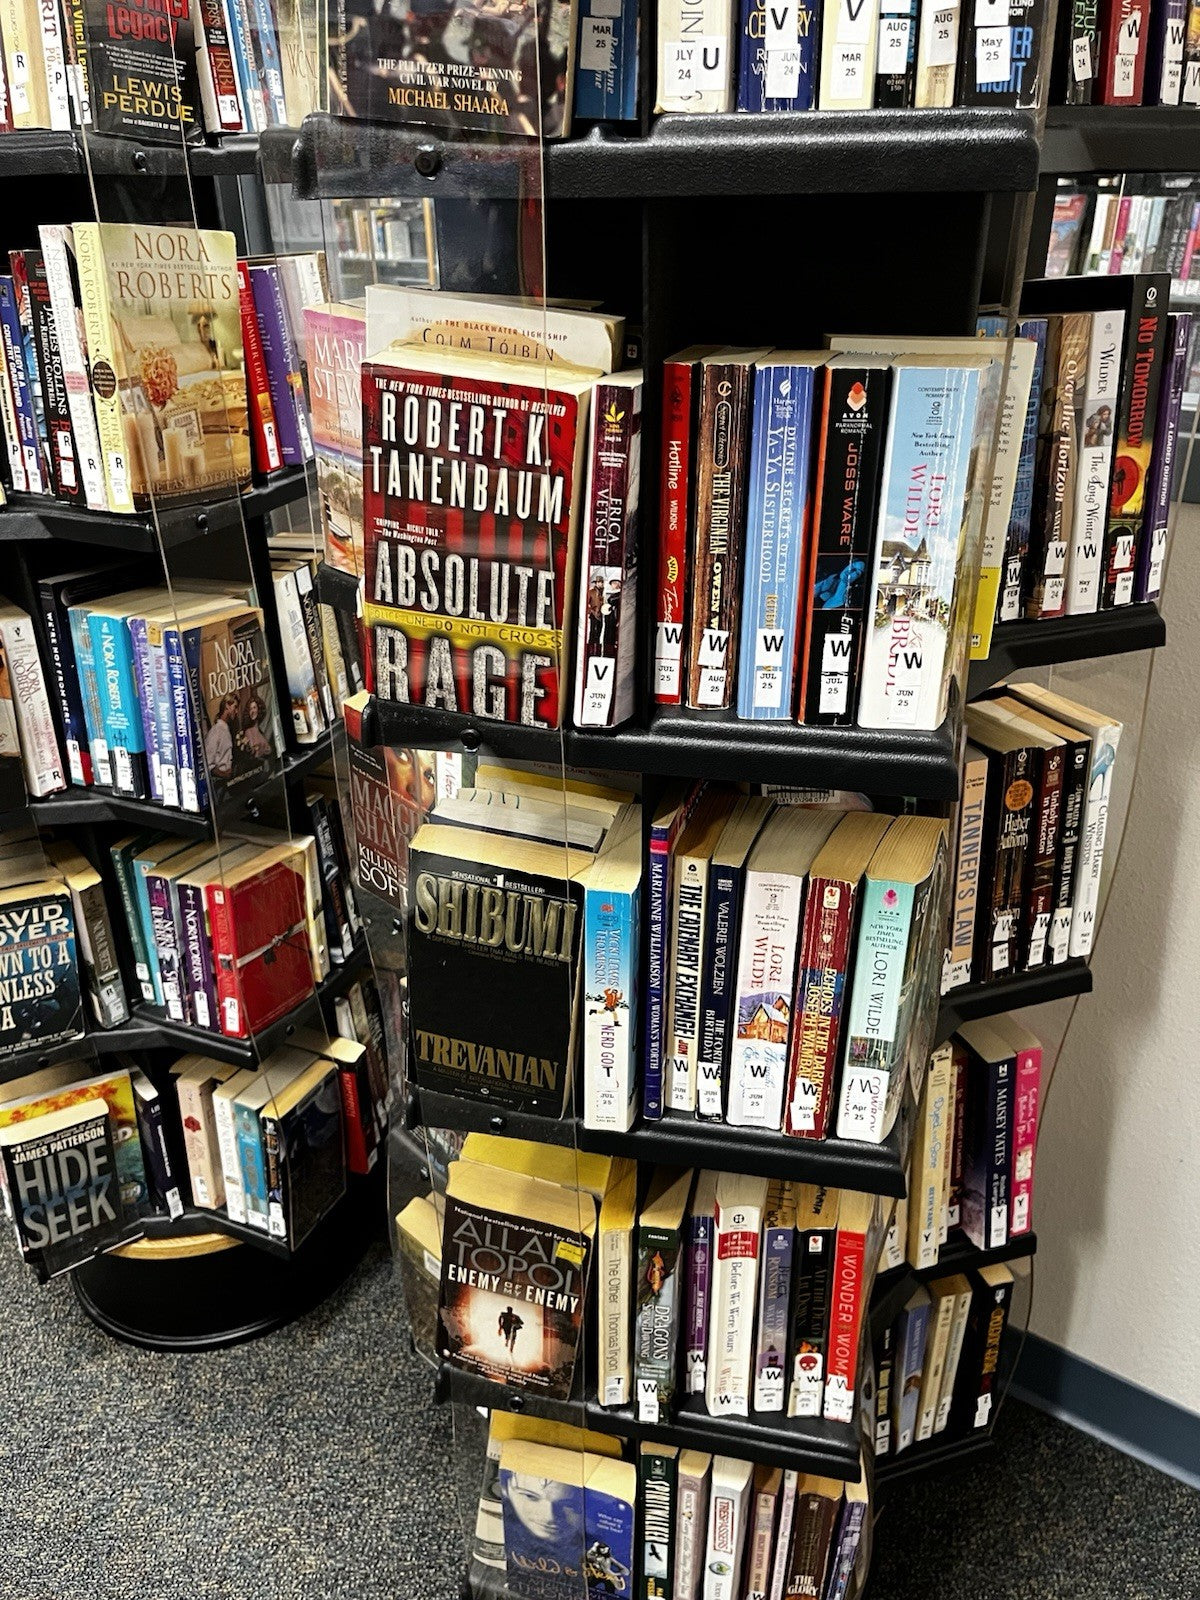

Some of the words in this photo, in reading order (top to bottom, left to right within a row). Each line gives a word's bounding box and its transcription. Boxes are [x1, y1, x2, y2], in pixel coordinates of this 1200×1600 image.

[107, 3, 180, 44] Legacy
[593, 25, 611, 35] MAR
[771, 7, 788, 30] V
[886, 22, 908, 32] AUG
[934, 13, 953, 24] AUG
[938, 30, 949, 39] 25
[676, 50, 693, 61] JLY
[703, 47, 719, 70] U
[842, 53, 861, 62] MAR
[890, 39, 902, 48] 25
[982, 37, 1003, 48] May
[1076, 44, 1087, 53] Dec
[16, 55, 25, 68] R
[377, 58, 396, 70] THE
[399, 60, 445, 75] PULITZER
[447, 64, 522, 82] PRIZE-WINNING
[678, 69, 691, 80] 24
[845, 68, 857, 77] 25
[1121, 58, 1133, 67] Nov
[1122, 71, 1130, 81] 24
[113, 75, 182, 102] LEWIS
[389, 87, 451, 110] MICHAEL
[454, 94, 509, 116] SHAARA
[400, 75, 426, 88] CIVIL
[428, 77, 450, 89] WAR
[451, 79, 484, 93] NOVEL
[486, 82, 499, 92] BY
[103, 92, 194, 122] PERDUE
[134, 232, 211, 263] NORA
[117, 271, 232, 300] ROBERTS
[445, 319, 461, 328] THE
[464, 322, 518, 336] BLACKWATER
[522, 330, 568, 342] LIGHTSHIP
[1138, 316, 1158, 343] NO
[44, 305, 60, 354] JAMES
[52, 355, 67, 415] ROLLINS
[1097, 343, 1116, 394] WILDER
[375, 377, 387, 389] THE
[389, 379, 404, 391] NEW
[406, 382, 424, 395] YORK
[426, 385, 446, 399] TIMES
[447, 388, 492, 406] BESTSELLING
[493, 395, 519, 410] AUTHOR
[521, 399, 529, 411] OF
[531, 400, 566, 417] RESOLVED
[1064, 360, 1077, 400] Over
[1061, 405, 1074, 428] the
[1126, 348, 1155, 449] TOMORROW
[381, 392, 506, 459] ROBERT
[526, 414, 551, 466] K.
[1163, 430, 1173, 464] LOADED
[669, 441, 682, 490] Hotline
[769, 427, 784, 475] YA-YA
[785, 427, 796, 474] DIVINE
[844, 443, 857, 491] JOSS
[1092, 454, 1104, 472] The
[167, 478, 192, 491] LAST
[195, 467, 249, 486] BOYFRIEND
[369, 446, 564, 524] TANENBAUM
[712, 472, 731, 495] THE
[1055, 437, 1071, 501] Horizon
[1160, 464, 1170, 506] QUESTION
[904, 464, 928, 539] WILDE
[926, 474, 947, 532] LORI
[1085, 473, 1105, 503] Long
[594, 489, 609, 550] VETSCH
[608, 497, 622, 545] ERICA
[669, 500, 678, 531] WILKINS
[709, 497, 730, 554] VIRGINIAN
[780, 482, 793, 540] SECRETS
[840, 497, 853, 546] WARE
[1085, 504, 1099, 540] Winter
[762, 482, 781, 583] SISTERHOOD
[780, 544, 787, 559] OF
[374, 541, 555, 629] ABSOLUTE
[710, 562, 722, 612] OWEN
[778, 562, 787, 583] THE
[47, 612, 57, 643] WE'RE
[406, 615, 429, 628] LINE
[435, 620, 453, 632] DO
[461, 624, 488, 638] NOT
[498, 628, 562, 650] CROSS
[51, 647, 60, 666] NOT
[102, 635, 114, 667] NORA
[214, 637, 252, 673] NORA
[56, 670, 65, 696] FROM
[106, 668, 121, 710] ROBERTS
[208, 659, 262, 699] ROBERTS
[375, 624, 550, 729] RAGE
[594, 665, 608, 681] V
[62, 699, 71, 723] HERE
[1048, 791, 1059, 825] Unholy
[1095, 805, 1108, 846] CHASING
[1038, 810, 1049, 854] Princeton
[1046, 827, 1055, 855] Death
[1083, 823, 1096, 866] WINSTON
[358, 842, 407, 885] KILLING
[958, 800, 982, 901] TANNER'S
[1091, 849, 1102, 879] HARRY
[451, 871, 491, 884] SENSATIONAL
[651, 862, 663, 921] MARIANNE
[415, 873, 578, 963] SHIBUMI
[716, 901, 729, 944] VALERIE
[954, 905, 973, 948] LAW
[29, 945, 52, 971] TO
[58, 941, 70, 965] A
[650, 923, 662, 989] WILLIAMSON
[676, 909, 702, 971] CATENARY
[712, 945, 727, 995] WOLZIEN
[751, 936, 769, 989] WILDE
[770, 945, 785, 982] LORI
[872, 951, 889, 987] LORI
[674, 971, 699, 1037] EXCHANGE
[805, 982, 820, 1028] JOSEPH
[821, 968, 837, 1013] ECHOES
[651, 1004, 660, 1041] WOMAN'S
[820, 1015, 831, 1028] IN
[866, 992, 884, 1035] WILDE
[601, 1025, 615, 1049] NERD
[702, 1009, 716, 1061] BIRTHDAY
[817, 1030, 830, 1052] THE
[415, 1029, 559, 1090] TREVANIAN
[650, 1042, 660, 1069] WORTH
[852, 1104, 867, 1112] Apr
[997, 1087, 1007, 1130] MAISEY
[13, 1144, 49, 1165] JAMES
[51, 1125, 105, 1154] PATTERSON
[995, 1132, 1006, 1166] YATES
[14, 1137, 108, 1206] HIDE
[23, 1173, 117, 1249] SEEK
[455, 1206, 483, 1220] National
[483, 1215, 519, 1230] Bestselling
[520, 1225, 543, 1236] Author
[553, 1234, 565, 1244] Spy
[453, 1239, 579, 1296] TOPOL
[609, 1258, 622, 1275] The
[730, 1262, 742, 1290] Before
[448, 1264, 500, 1293] ENEMY
[504, 1289, 523, 1297] MY
[525, 1287, 579, 1314] ENEMY
[609, 1277, 621, 1303] Other
[730, 1292, 741, 1302] We
[839, 1254, 858, 1322] WONDER
[609, 1312, 622, 1348] Thomas
[653, 1305, 670, 1360] DRAGONS
[729, 1306, 740, 1328] Were
[607, 1348, 621, 1370] Tryon
[727, 1330, 738, 1353] Yours
[787, 1584, 818, 1597] GLORY
